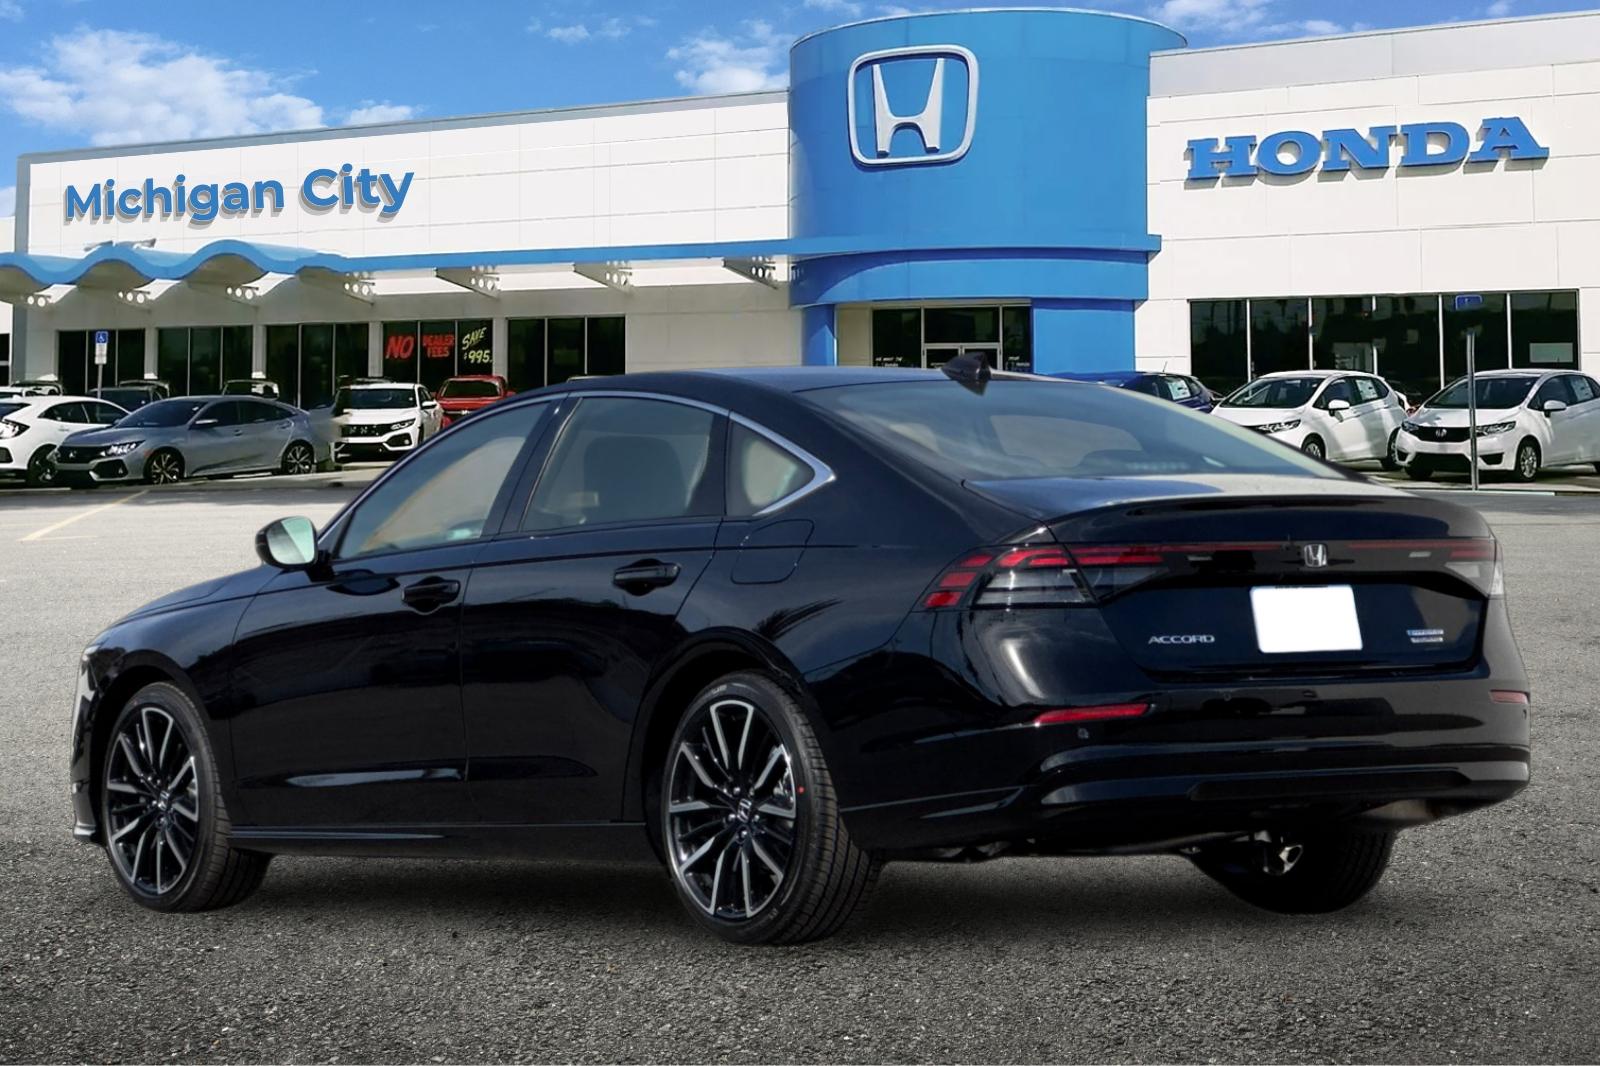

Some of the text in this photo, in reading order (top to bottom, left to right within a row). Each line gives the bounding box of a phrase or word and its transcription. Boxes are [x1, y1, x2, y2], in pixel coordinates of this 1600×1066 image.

[1187, 116, 1550, 179] HONDA
[66, 163, 415, 222] Michigan City
[385, 335, 415, 359] NO
[462, 327, 487, 350] SAVE
[1148, 634, 1216, 645] ACCORD
